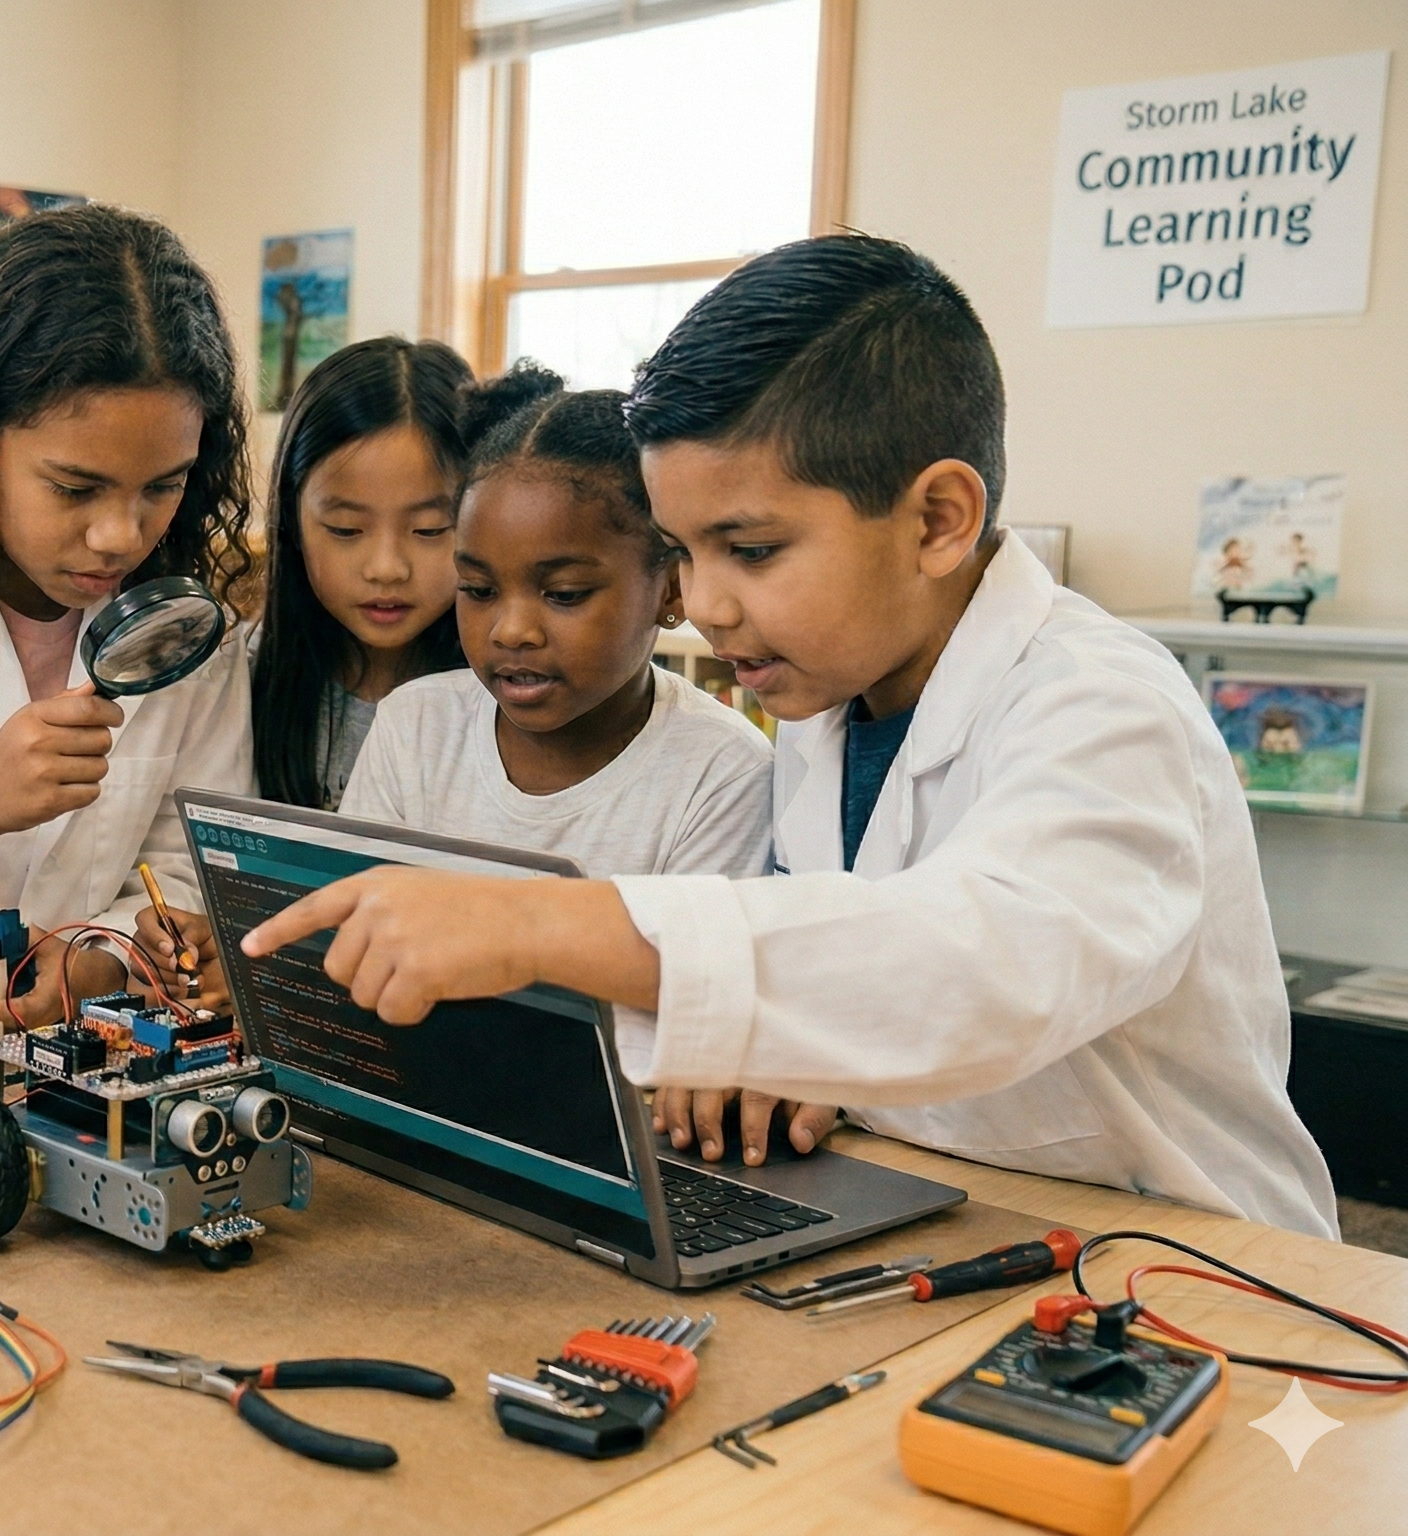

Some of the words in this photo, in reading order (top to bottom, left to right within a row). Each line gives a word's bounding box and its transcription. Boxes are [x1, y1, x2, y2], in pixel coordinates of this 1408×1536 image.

[1126, 98, 1219, 131] Storm
[1230, 83, 1308, 122] Lake
[1076, 124, 1358, 193] Community
[1103, 190, 1315, 247] Learning
[1155, 252, 1246, 304] Pod
